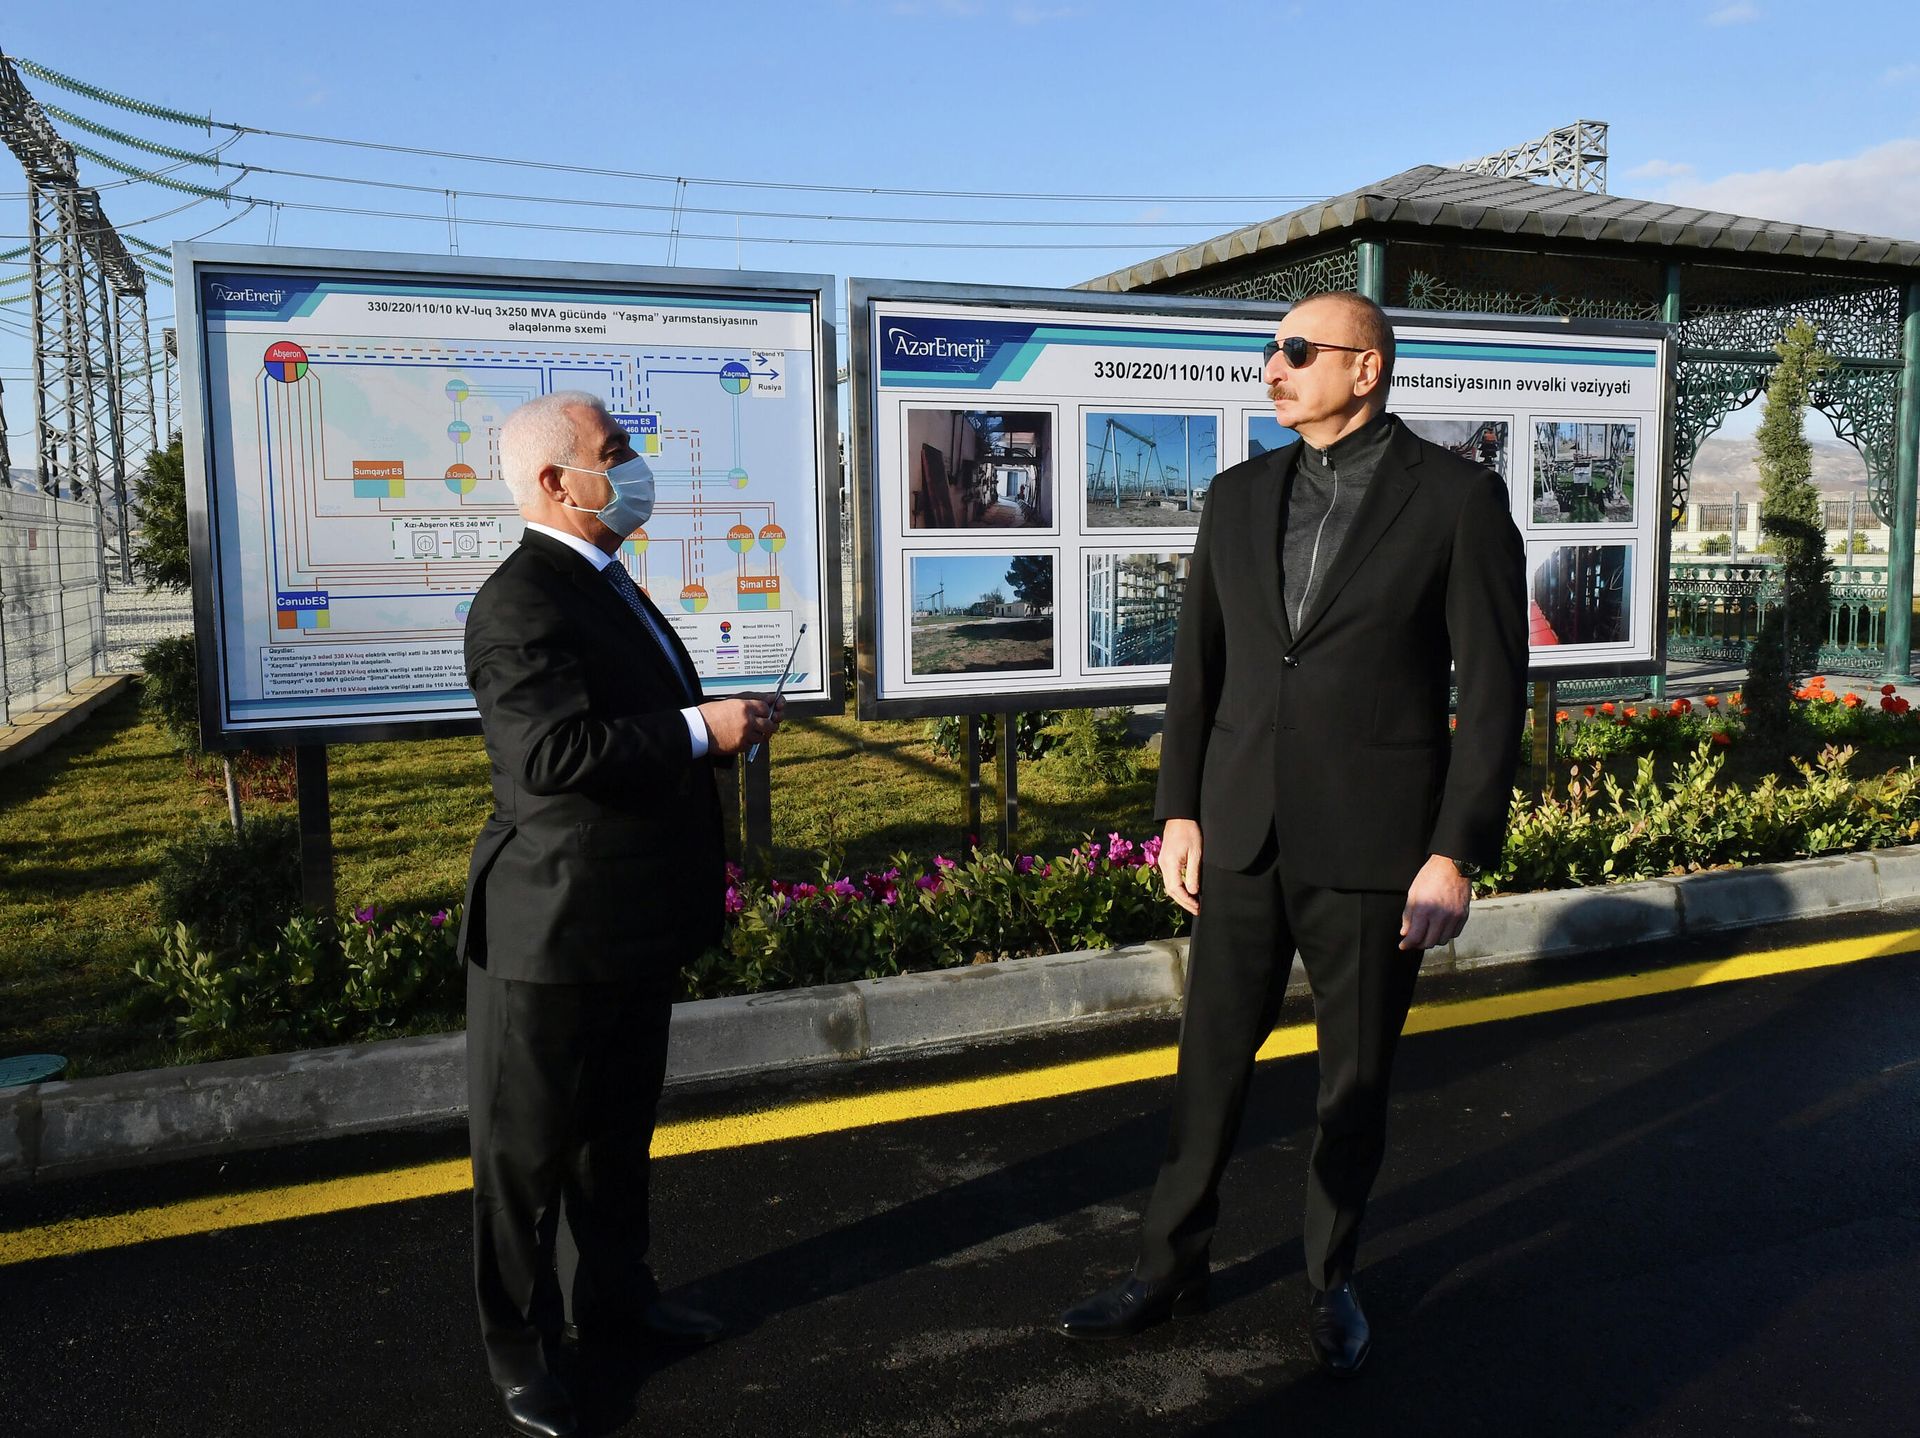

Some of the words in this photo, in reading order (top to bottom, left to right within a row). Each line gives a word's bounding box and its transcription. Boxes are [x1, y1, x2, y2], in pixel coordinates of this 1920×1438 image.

[215, 288, 282, 305] AzərEnerji
[367, 301, 452, 314] 330/220/110/10
[455, 304, 492, 318] kV-luq
[495, 306, 527, 317] 3x250
[531, 308, 556, 318] MVA
[559, 308, 607, 321] gücündə
[662, 313, 758, 327] yarımstansiyasının
[508, 321, 571, 334] əlaqələnmə
[574, 324, 606, 334] sxemi
[272, 348, 301, 359] Abşeron
[894, 335, 984, 363] AzərEnerji
[1093, 361, 1225, 382] 330/220/110/10
[1230, 366, 1262, 383] kV-l
[1391, 373, 1511, 392] ımstansiyasının
[1516, 376, 1566, 393] əvvəlki
[1570, 378, 1631, 397] vəziyyəti
[758, 383, 782, 391] Rusiya
[614, 417, 639, 426] Yaşma
[354, 467, 391, 477] Sumqayıt
[391, 467, 403, 475] ES
[739, 580, 763, 590] Şimal
[764, 579, 777, 588] ES
[277, 596, 327, 606] CənubES
